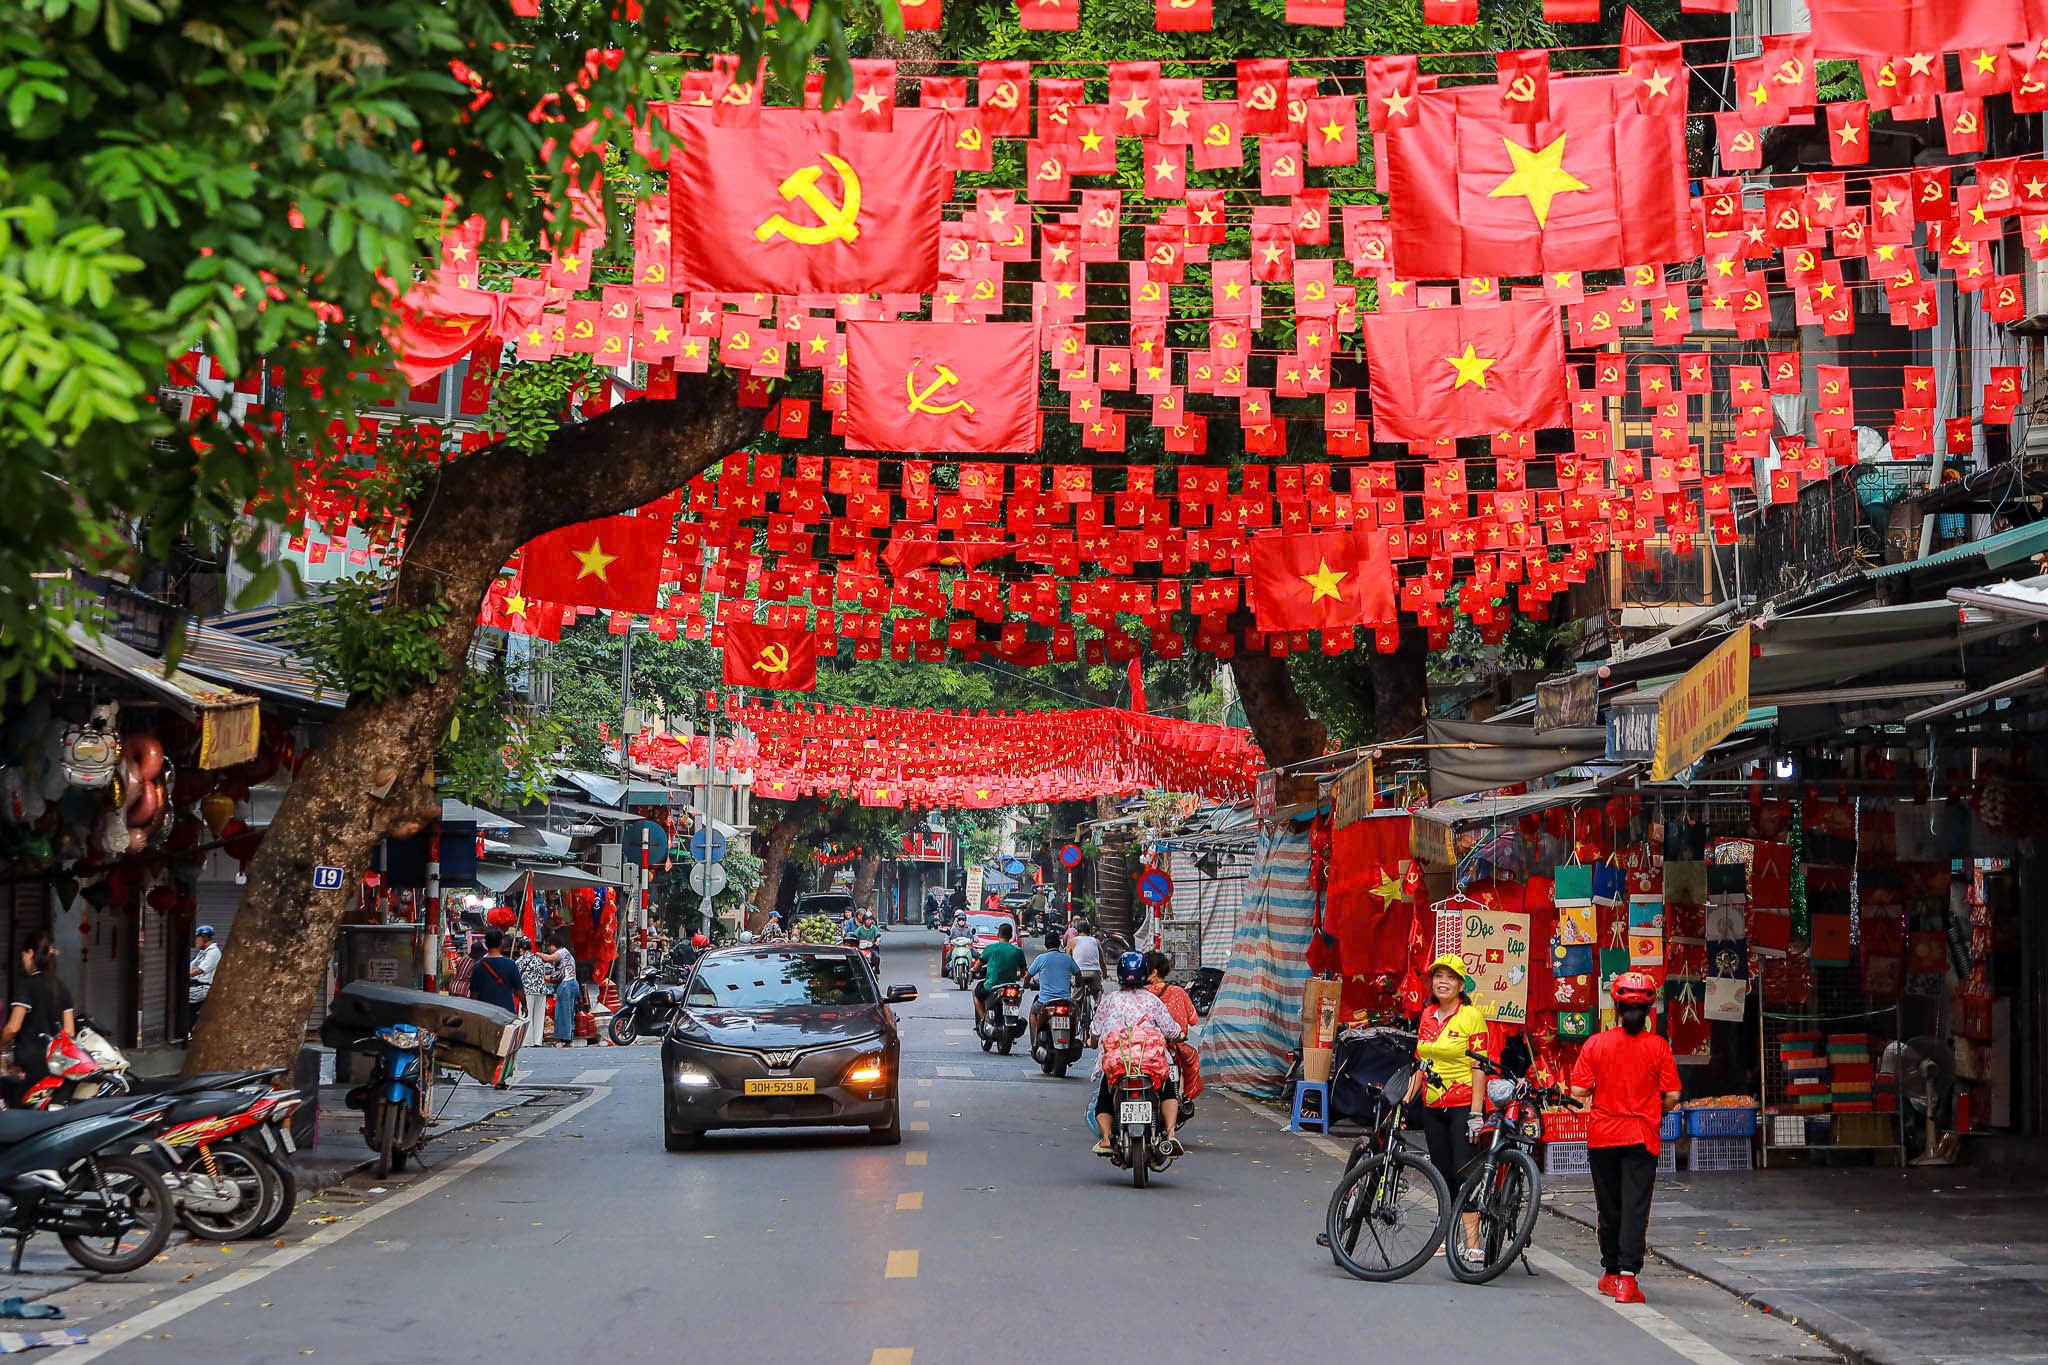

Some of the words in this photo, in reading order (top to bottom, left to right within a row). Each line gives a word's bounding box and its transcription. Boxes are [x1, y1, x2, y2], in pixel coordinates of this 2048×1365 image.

[320, 869, 337, 885] 19
[1465, 915, 1494, 939] Độc
[1507, 937, 1526, 957] lập
[1462, 952, 1486, 976] Tự
[1494, 976, 1508, 991] do
[1497, 1001, 1526, 1020] phúc
[751, 1082, 809, 1093] 30H-529.84
